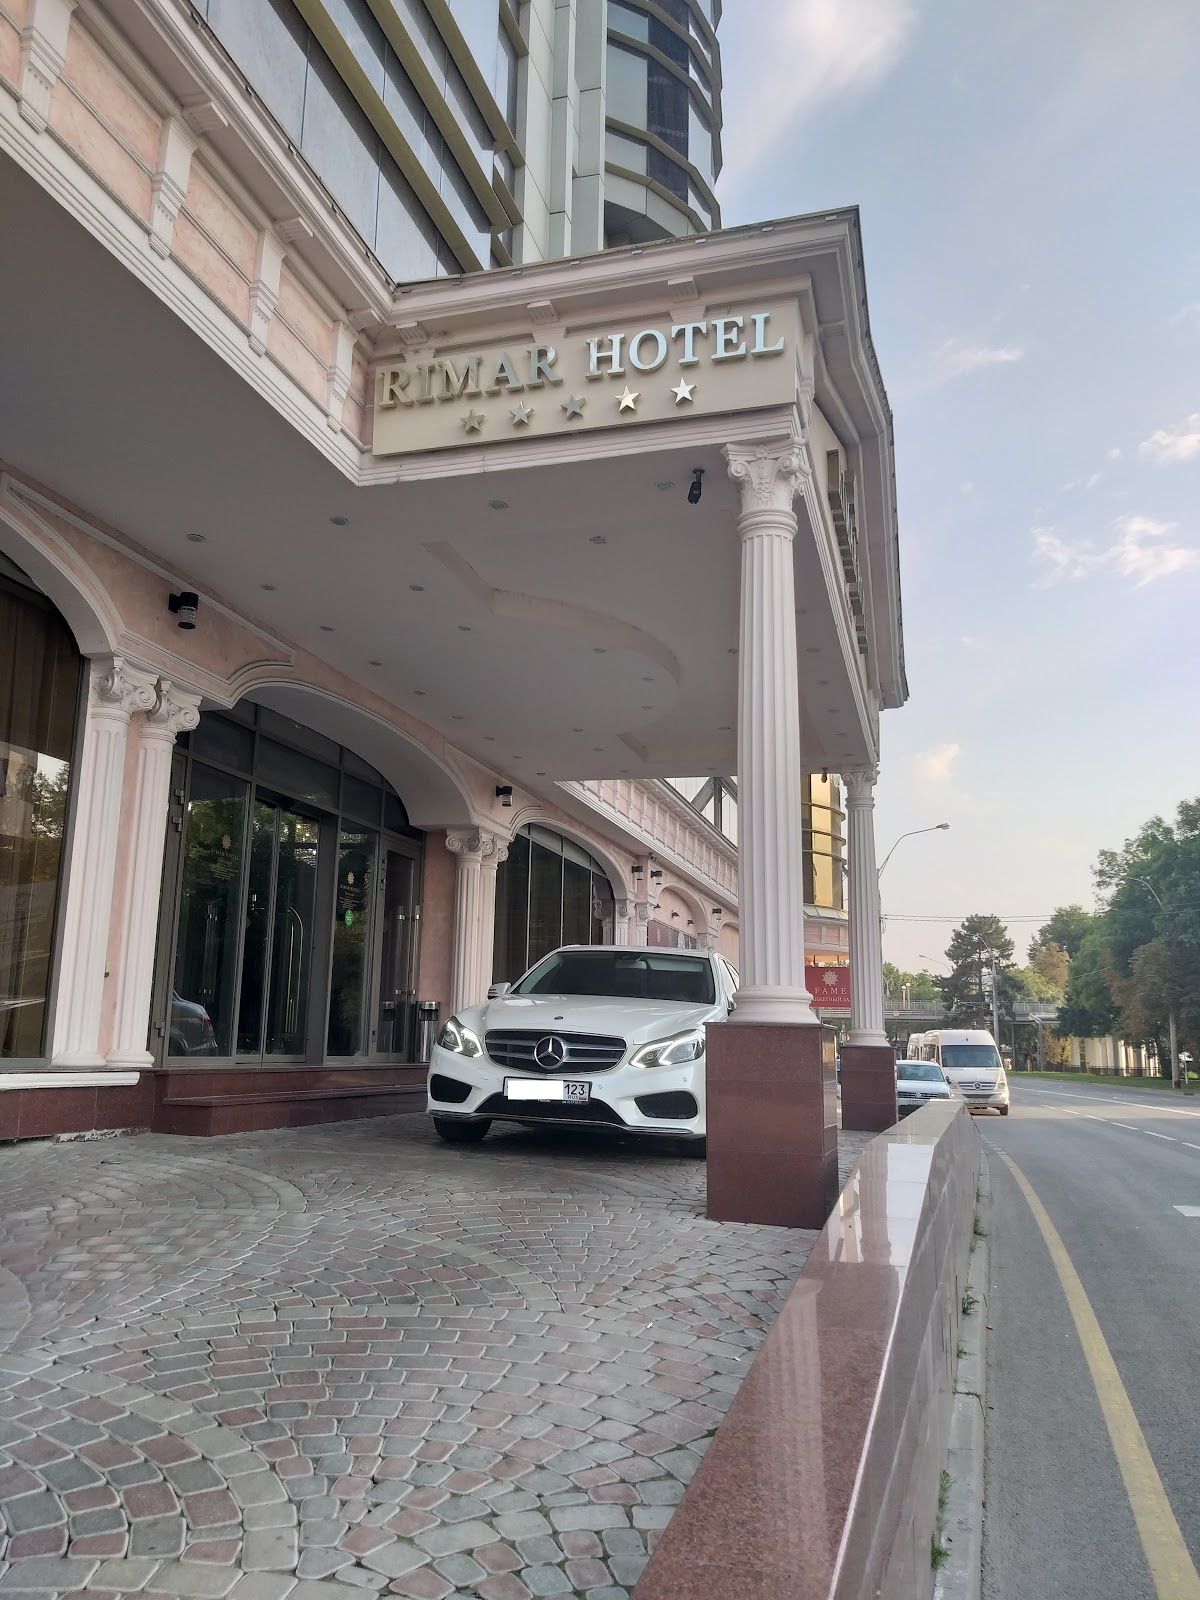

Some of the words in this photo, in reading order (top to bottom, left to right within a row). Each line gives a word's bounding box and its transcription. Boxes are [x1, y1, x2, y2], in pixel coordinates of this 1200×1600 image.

[378, 344, 563, 409] RIMAR
[584, 312, 786, 381] HOTEL
[814, 987, 847, 995] FAME
[564, 1084, 585, 1096] 123
